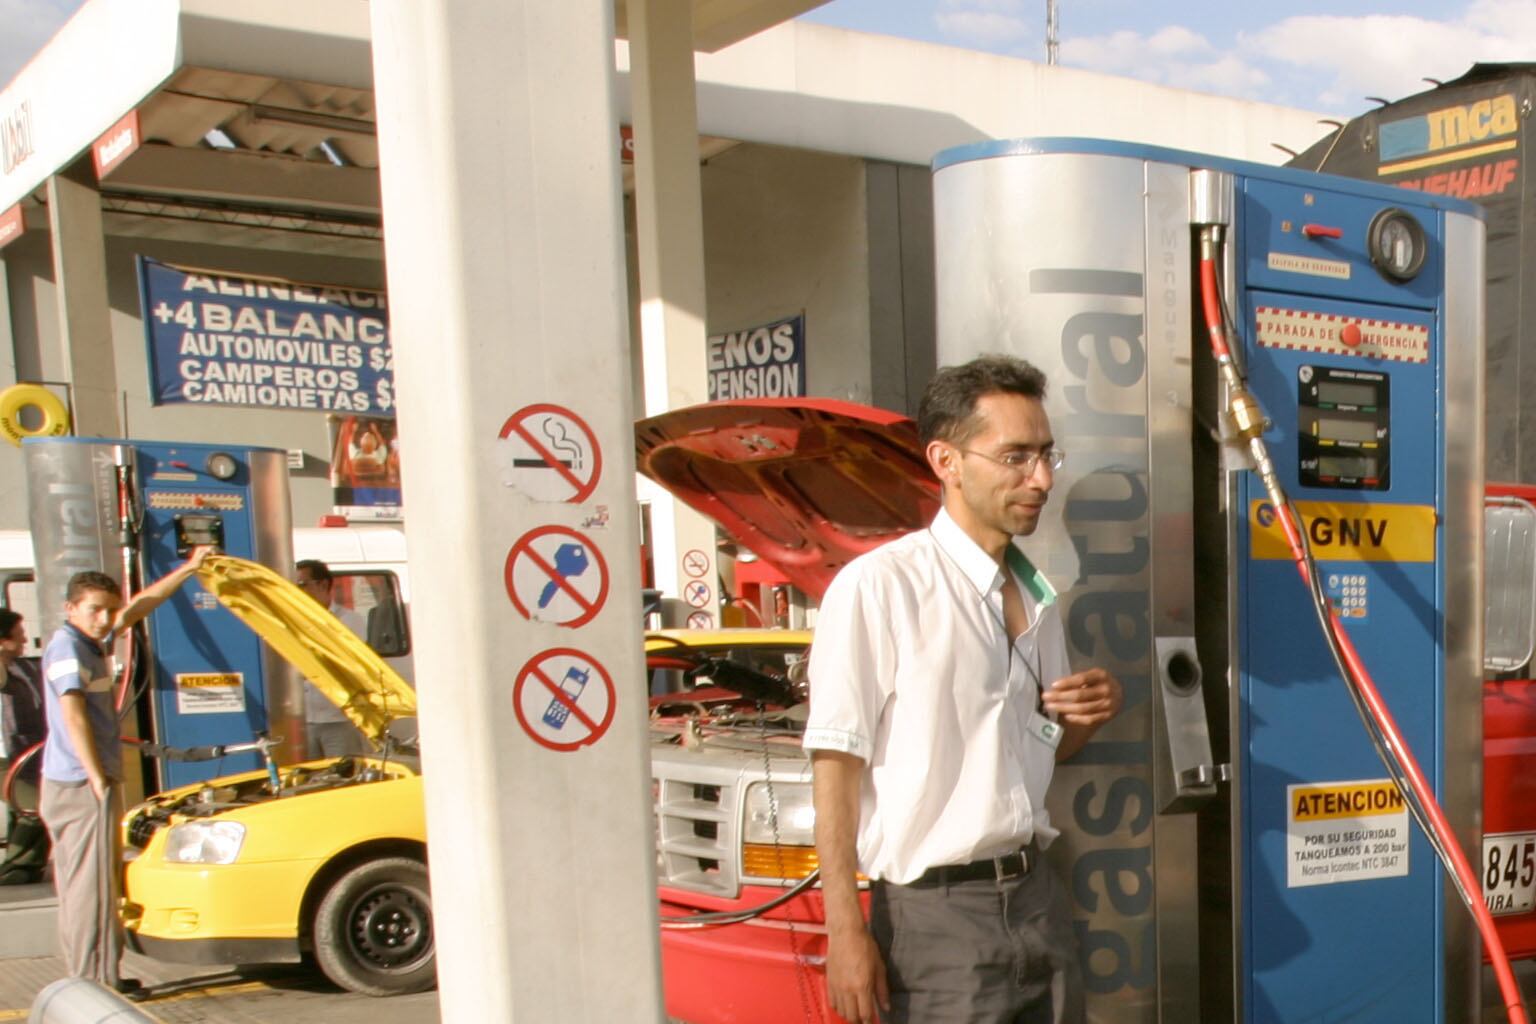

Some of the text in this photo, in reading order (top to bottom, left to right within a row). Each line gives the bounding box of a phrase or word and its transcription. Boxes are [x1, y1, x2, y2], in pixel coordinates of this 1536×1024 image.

[202, 303, 391, 344] BALANC
[1267, 322, 1418, 350] PARADA DE MERGENCIA
[180, 332, 363, 369] AUTOMOVILES
[179, 359, 359, 391] CAMPEROS
[182, 381, 369, 412] CAMIONETAS
[1310, 517, 1388, 547] GNV
[1296, 788, 1403, 816] ATENCION
[1295, 846, 1361, 861] TANQUEAMOS
[1364, 845, 1371, 854] A
[1373, 842, 1389, 854] 200
[1304, 828, 1397, 846] POR SU SEGURIDAD
[1302, 864, 1329, 876] Norma
[1486, 843, 1535, 891] 845
